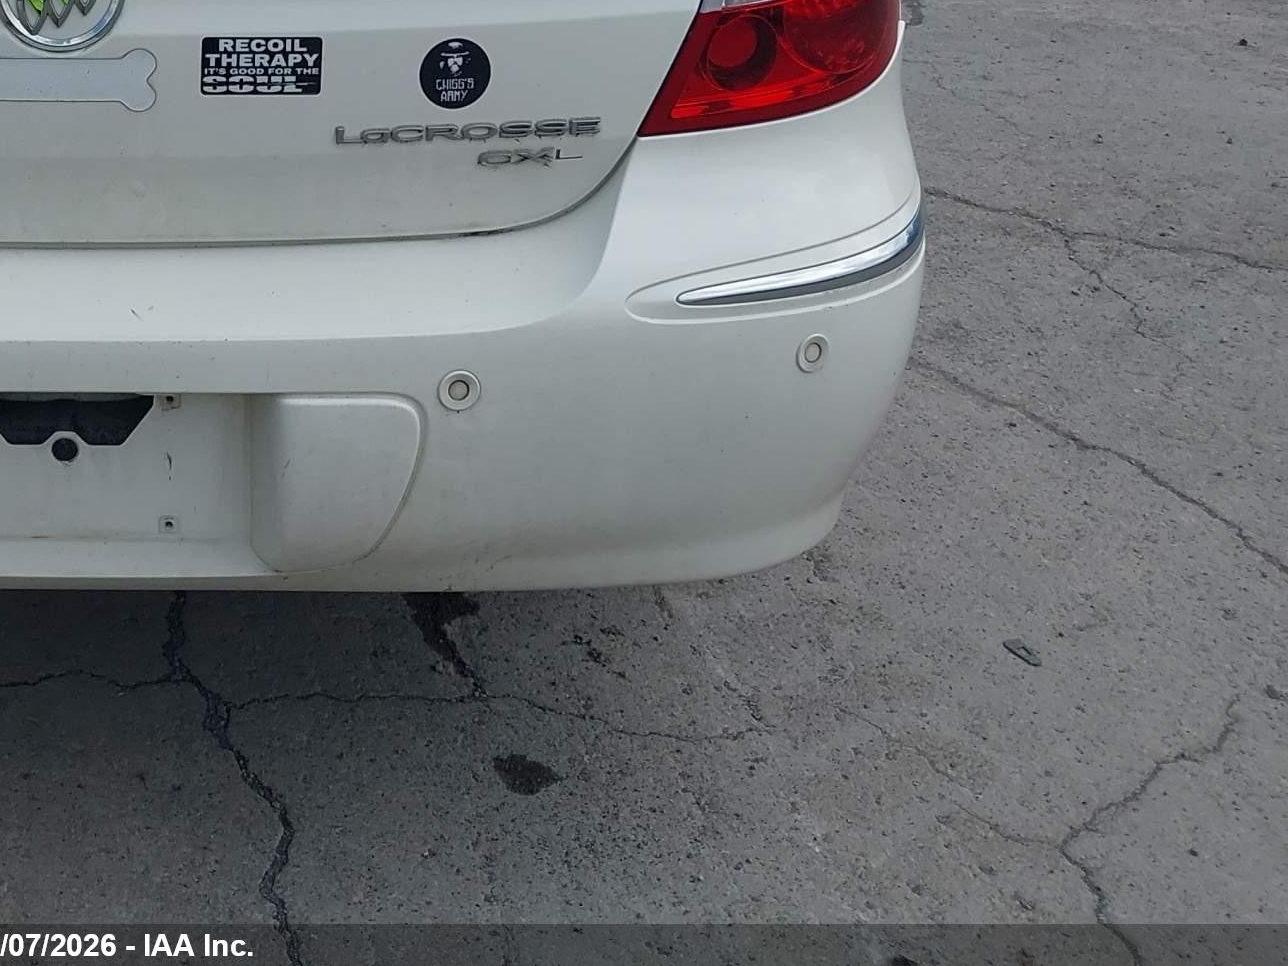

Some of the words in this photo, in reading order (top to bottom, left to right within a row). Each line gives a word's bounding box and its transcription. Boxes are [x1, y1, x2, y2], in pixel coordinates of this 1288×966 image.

[218, 38, 307, 52] RECOIL
[205, 54, 319, 67] THERAPY
[440, 90, 468, 102] ARMY
[477, 146, 583, 168] CXL
